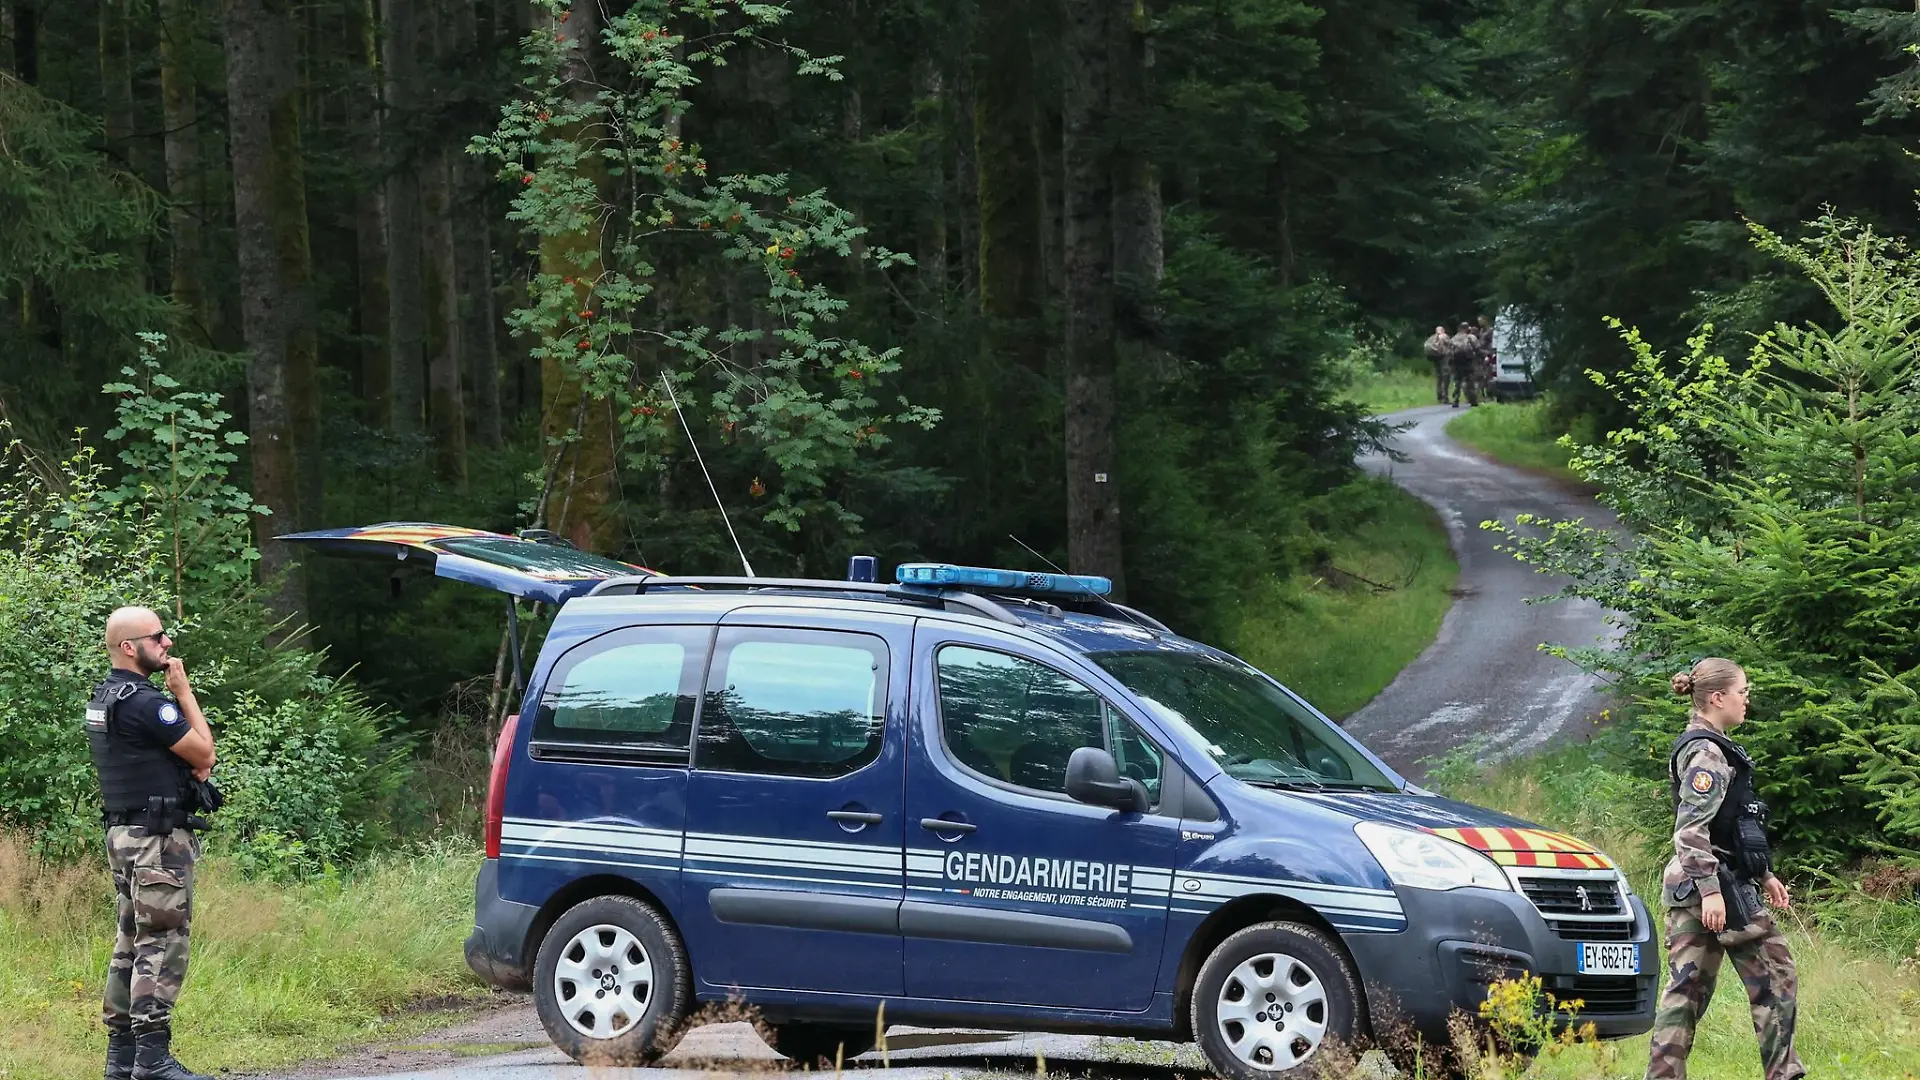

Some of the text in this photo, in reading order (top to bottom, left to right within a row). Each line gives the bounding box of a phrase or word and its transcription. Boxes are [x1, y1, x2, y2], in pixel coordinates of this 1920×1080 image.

[945, 850, 1131, 894] GENDARMERIE
[973, 887, 1128, 909] NOTRE ENGAGEMENT, VOTRE SÉCURITÉ
